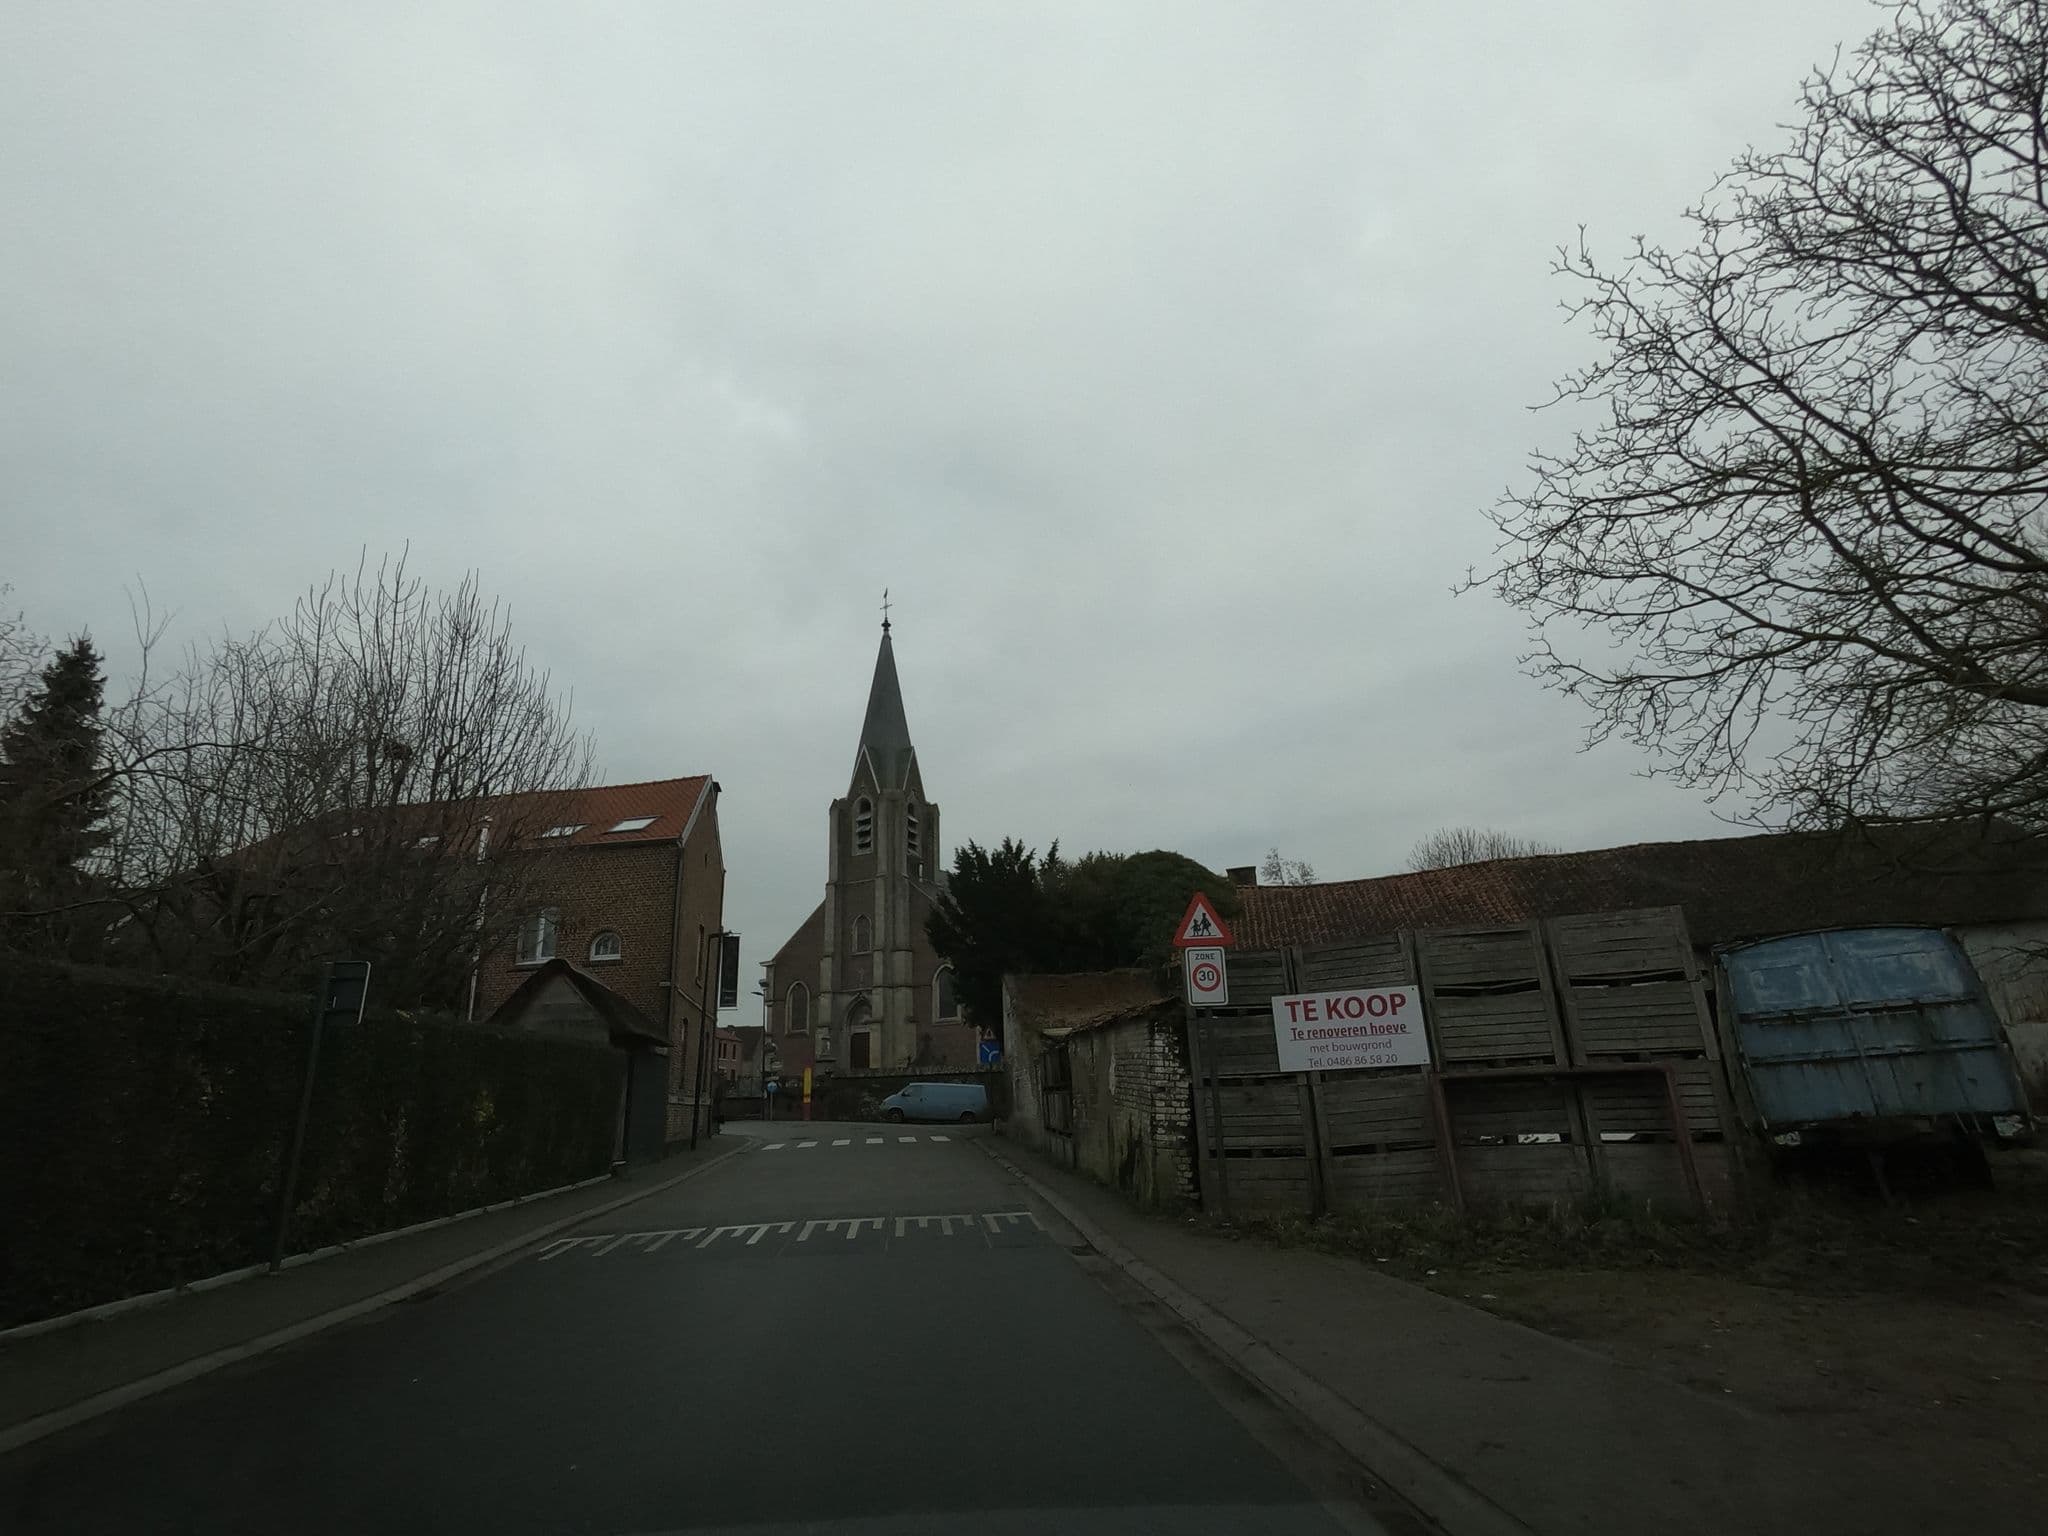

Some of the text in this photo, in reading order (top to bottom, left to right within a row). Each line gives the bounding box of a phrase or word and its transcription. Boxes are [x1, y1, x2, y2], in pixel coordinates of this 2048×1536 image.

[1199, 970, 1214, 981] 30
[1284, 993, 1406, 1022] TE KOOP
[1370, 1022, 1406, 1034] hoeve
[1310, 1039, 1392, 1053] met bouwgrond
[1308, 1053, 1398, 1068] Tel. 0486 86 58 20
